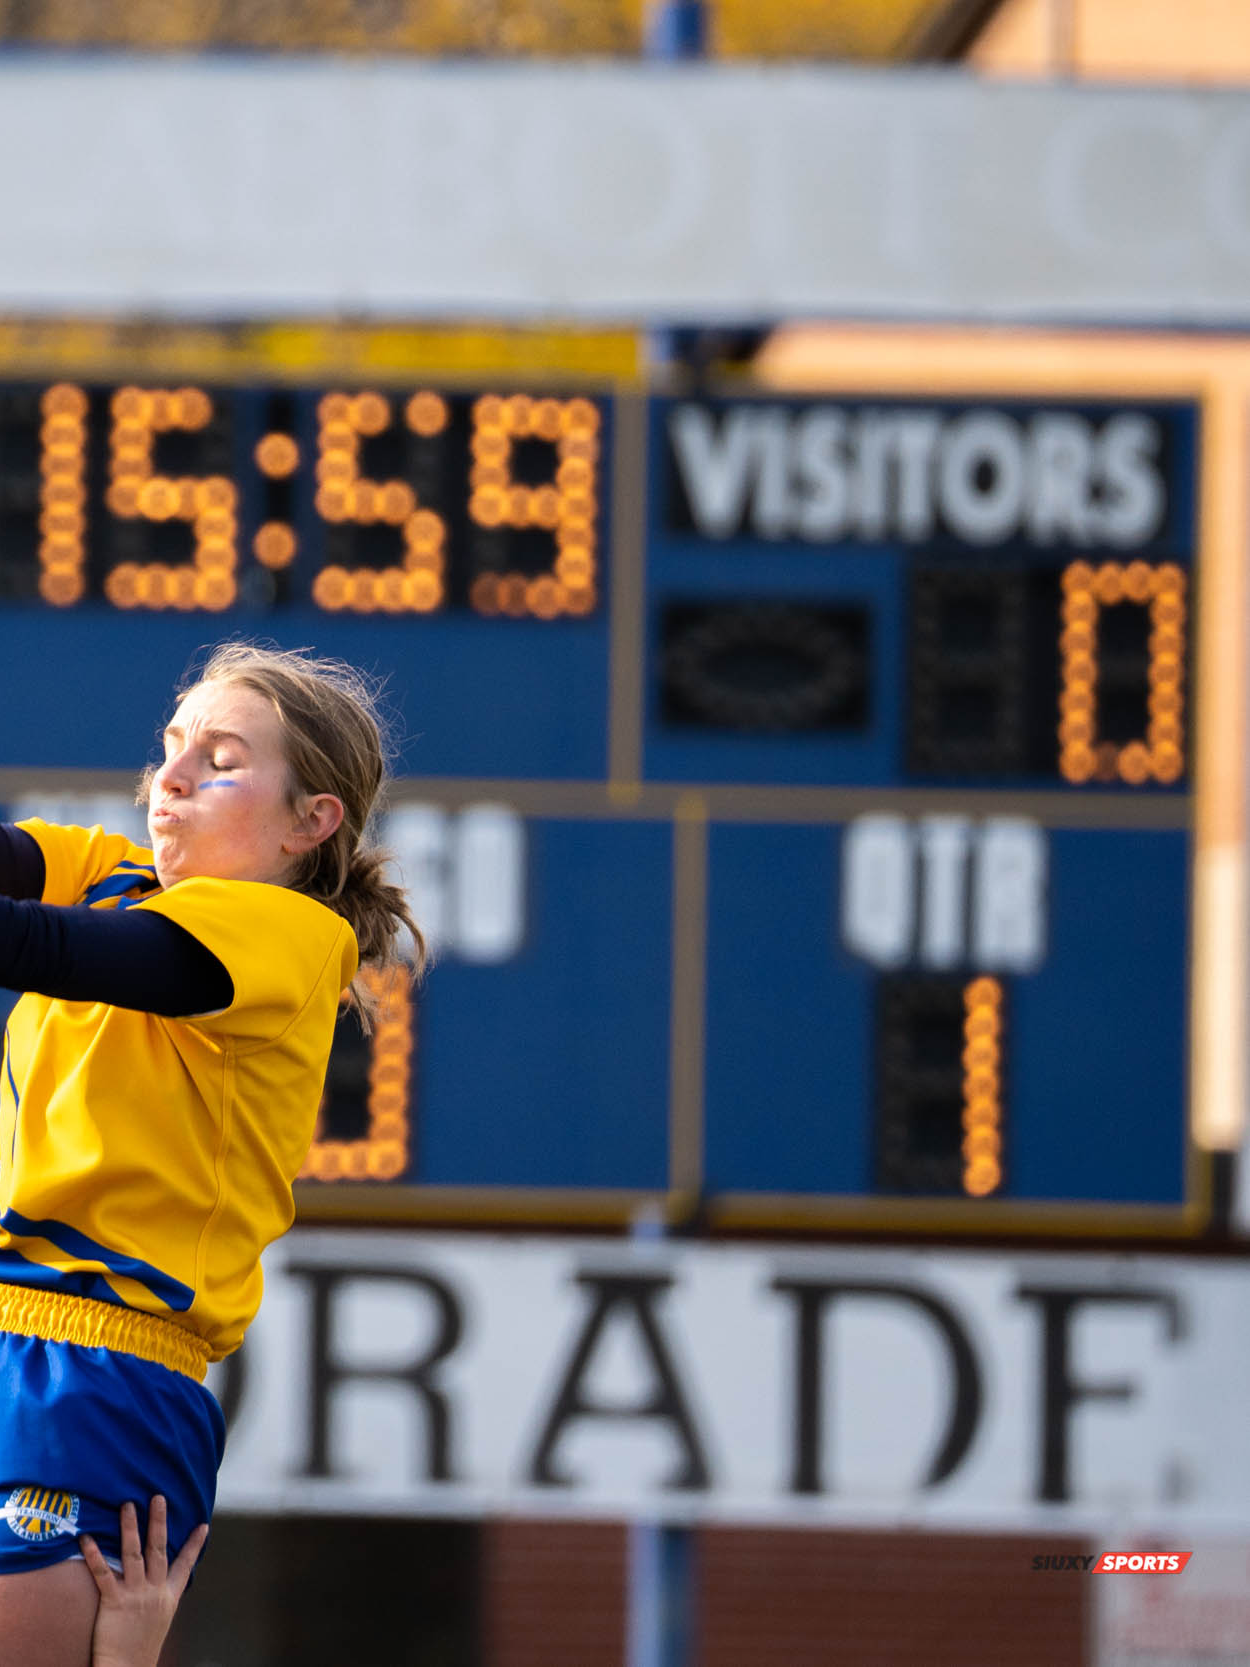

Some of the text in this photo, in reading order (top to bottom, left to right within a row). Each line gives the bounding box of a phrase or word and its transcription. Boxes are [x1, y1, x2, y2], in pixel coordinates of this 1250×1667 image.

[39, 384, 598, 620] 15:59
[668, 403, 1166, 546] VISITORS
[844, 812, 1047, 974] QTR
[961, 976, 1003, 1197] 1
